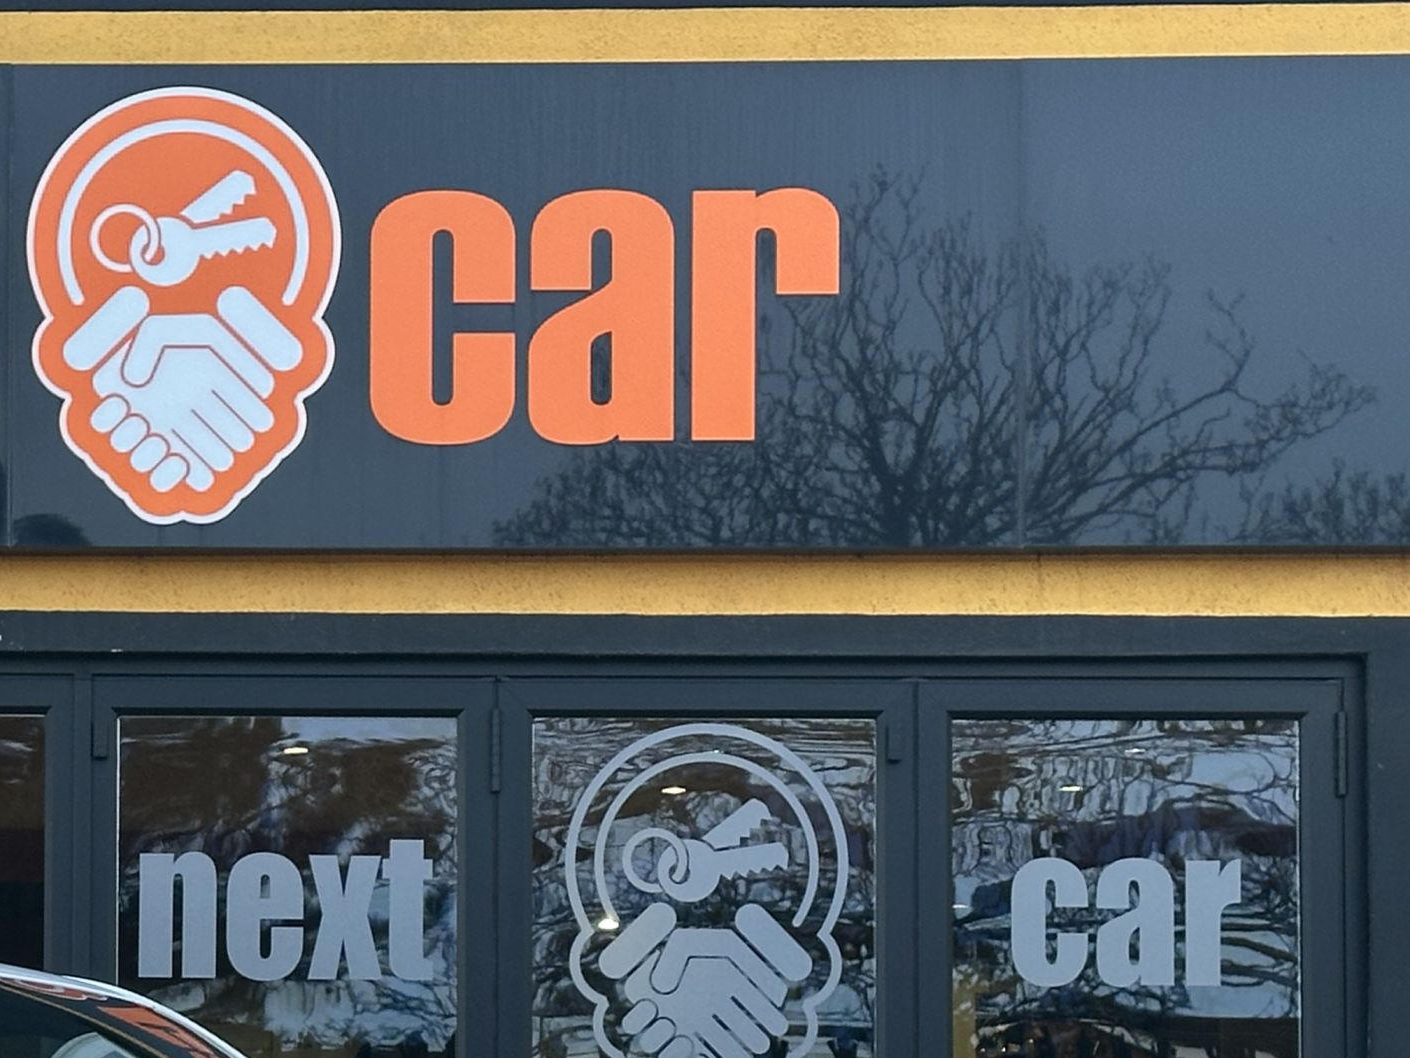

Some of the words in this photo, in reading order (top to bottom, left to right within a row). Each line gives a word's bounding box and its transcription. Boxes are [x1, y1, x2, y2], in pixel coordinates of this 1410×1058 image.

[369, 188, 842, 444] car
[137, 838, 434, 982] next
[1009, 856, 1242, 988] car
